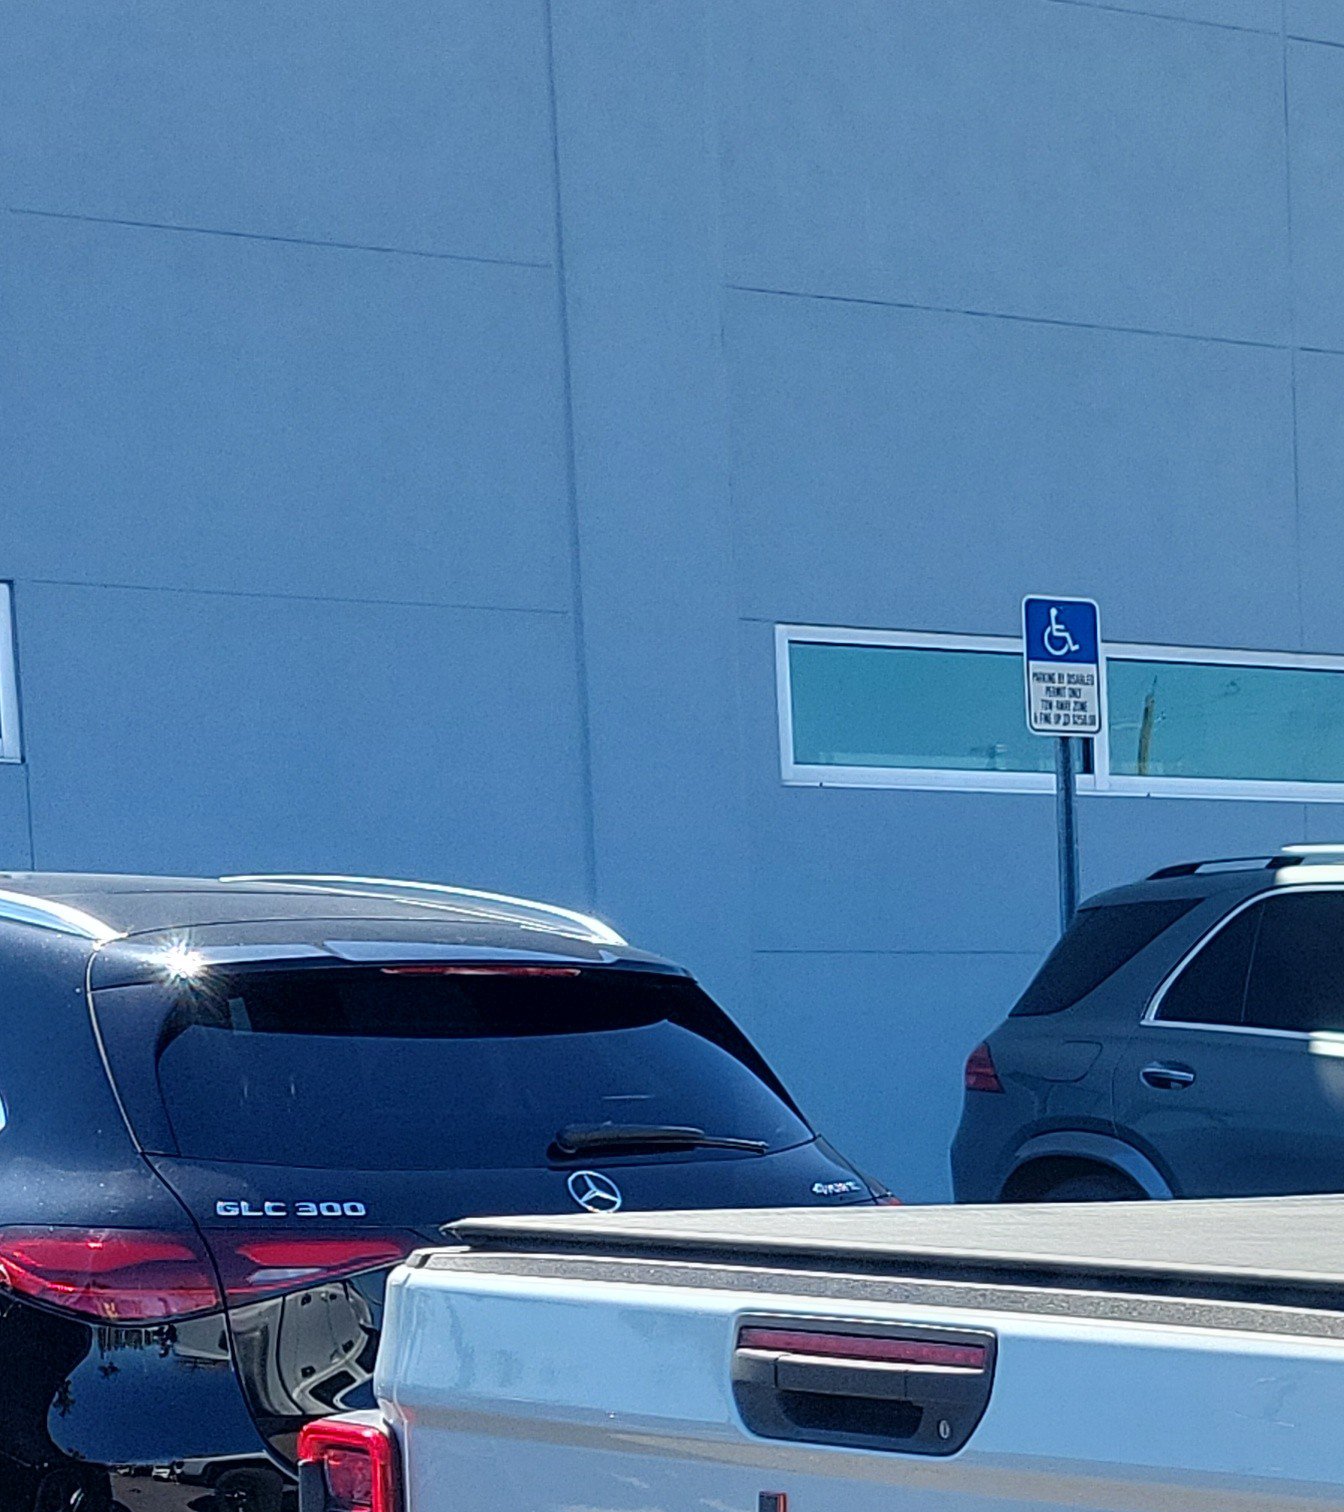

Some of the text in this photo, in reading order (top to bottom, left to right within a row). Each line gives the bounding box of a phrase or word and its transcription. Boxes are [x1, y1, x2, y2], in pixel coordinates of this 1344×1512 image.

[1033, 672, 1095, 686] PARKING BY DISABLED
[1045, 686, 1081, 699] PERMIT ONLY
[1041, 699, 1053, 711] TOW
[1072, 700, 1088, 713] ZONE
[1039, 712, 1052, 725] FINE
[216, 1201, 366, 1216] GLC 300
